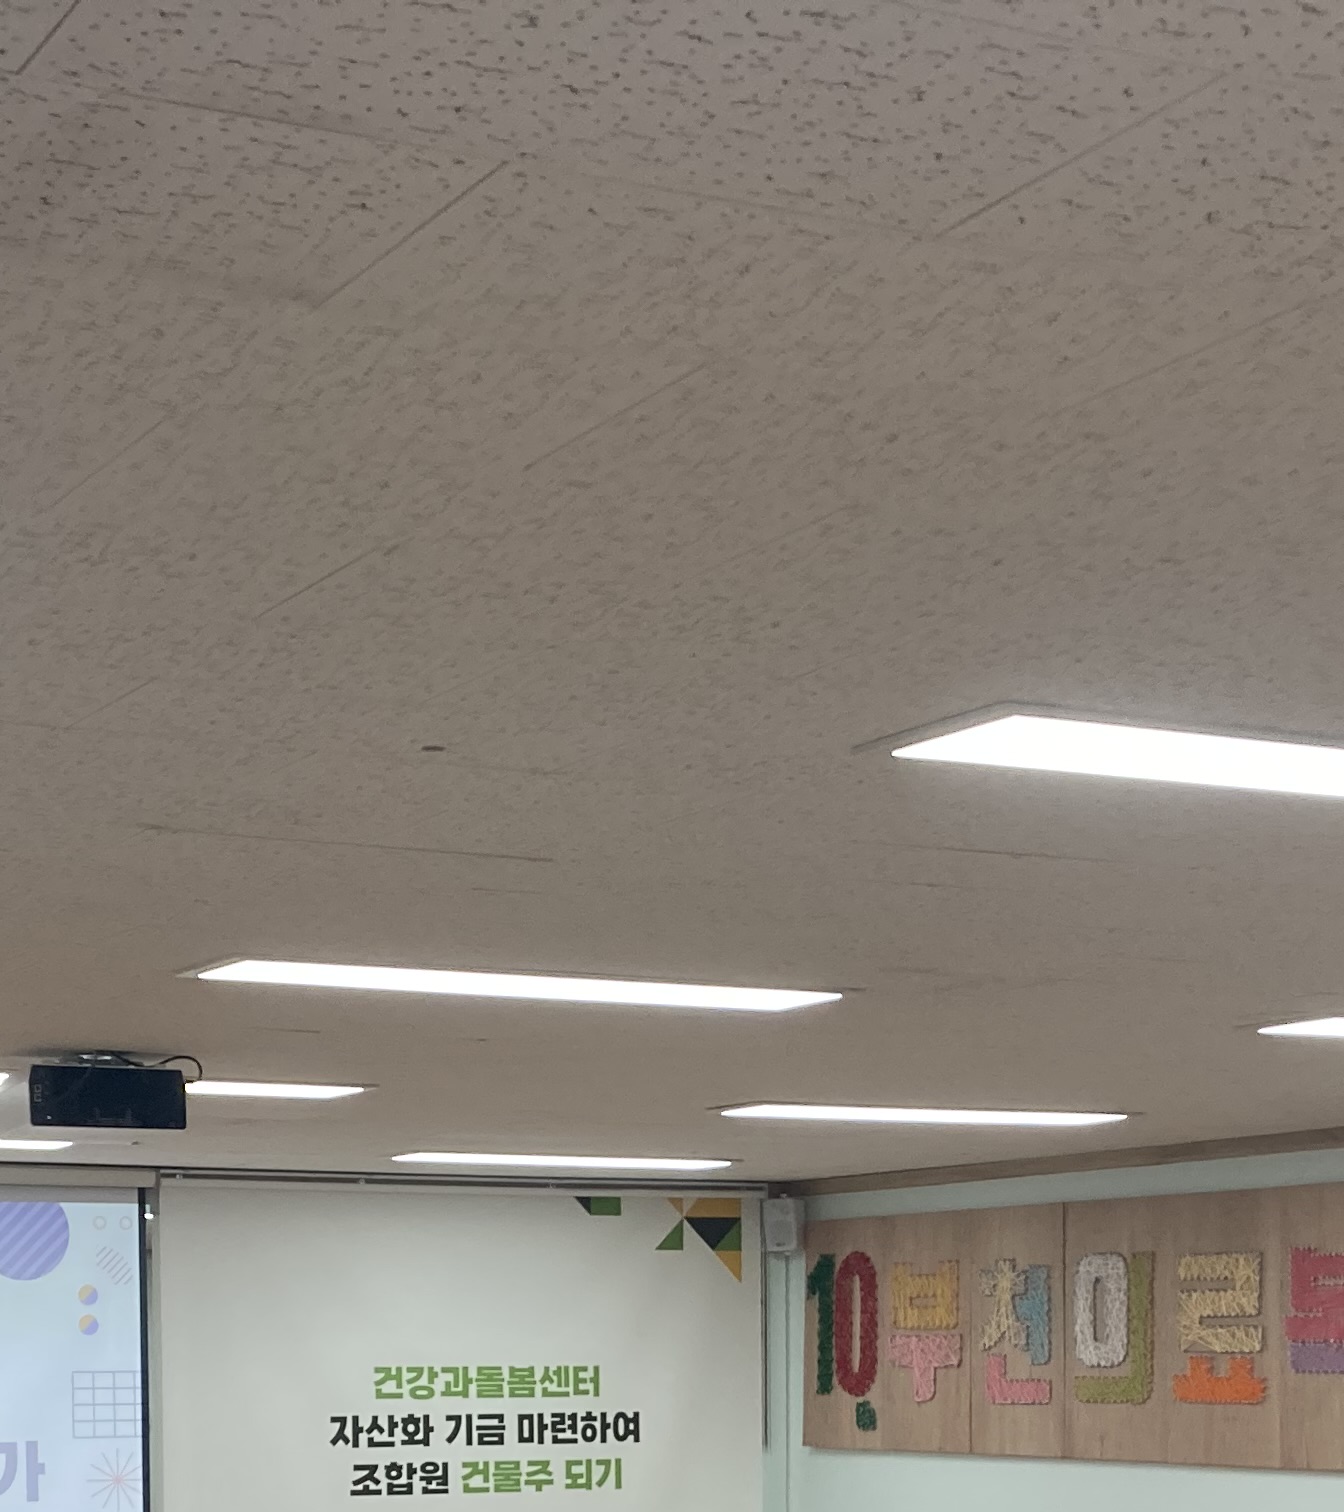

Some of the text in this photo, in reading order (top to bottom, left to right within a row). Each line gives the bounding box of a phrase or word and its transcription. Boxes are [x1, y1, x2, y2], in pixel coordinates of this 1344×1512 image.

[372, 1366, 600, 1398] 건강과돌봄센터
[329, 1411, 640, 1447] 자산화 기금 마련하여
[349, 1458, 622, 1496] 조합원 건물주 되기
